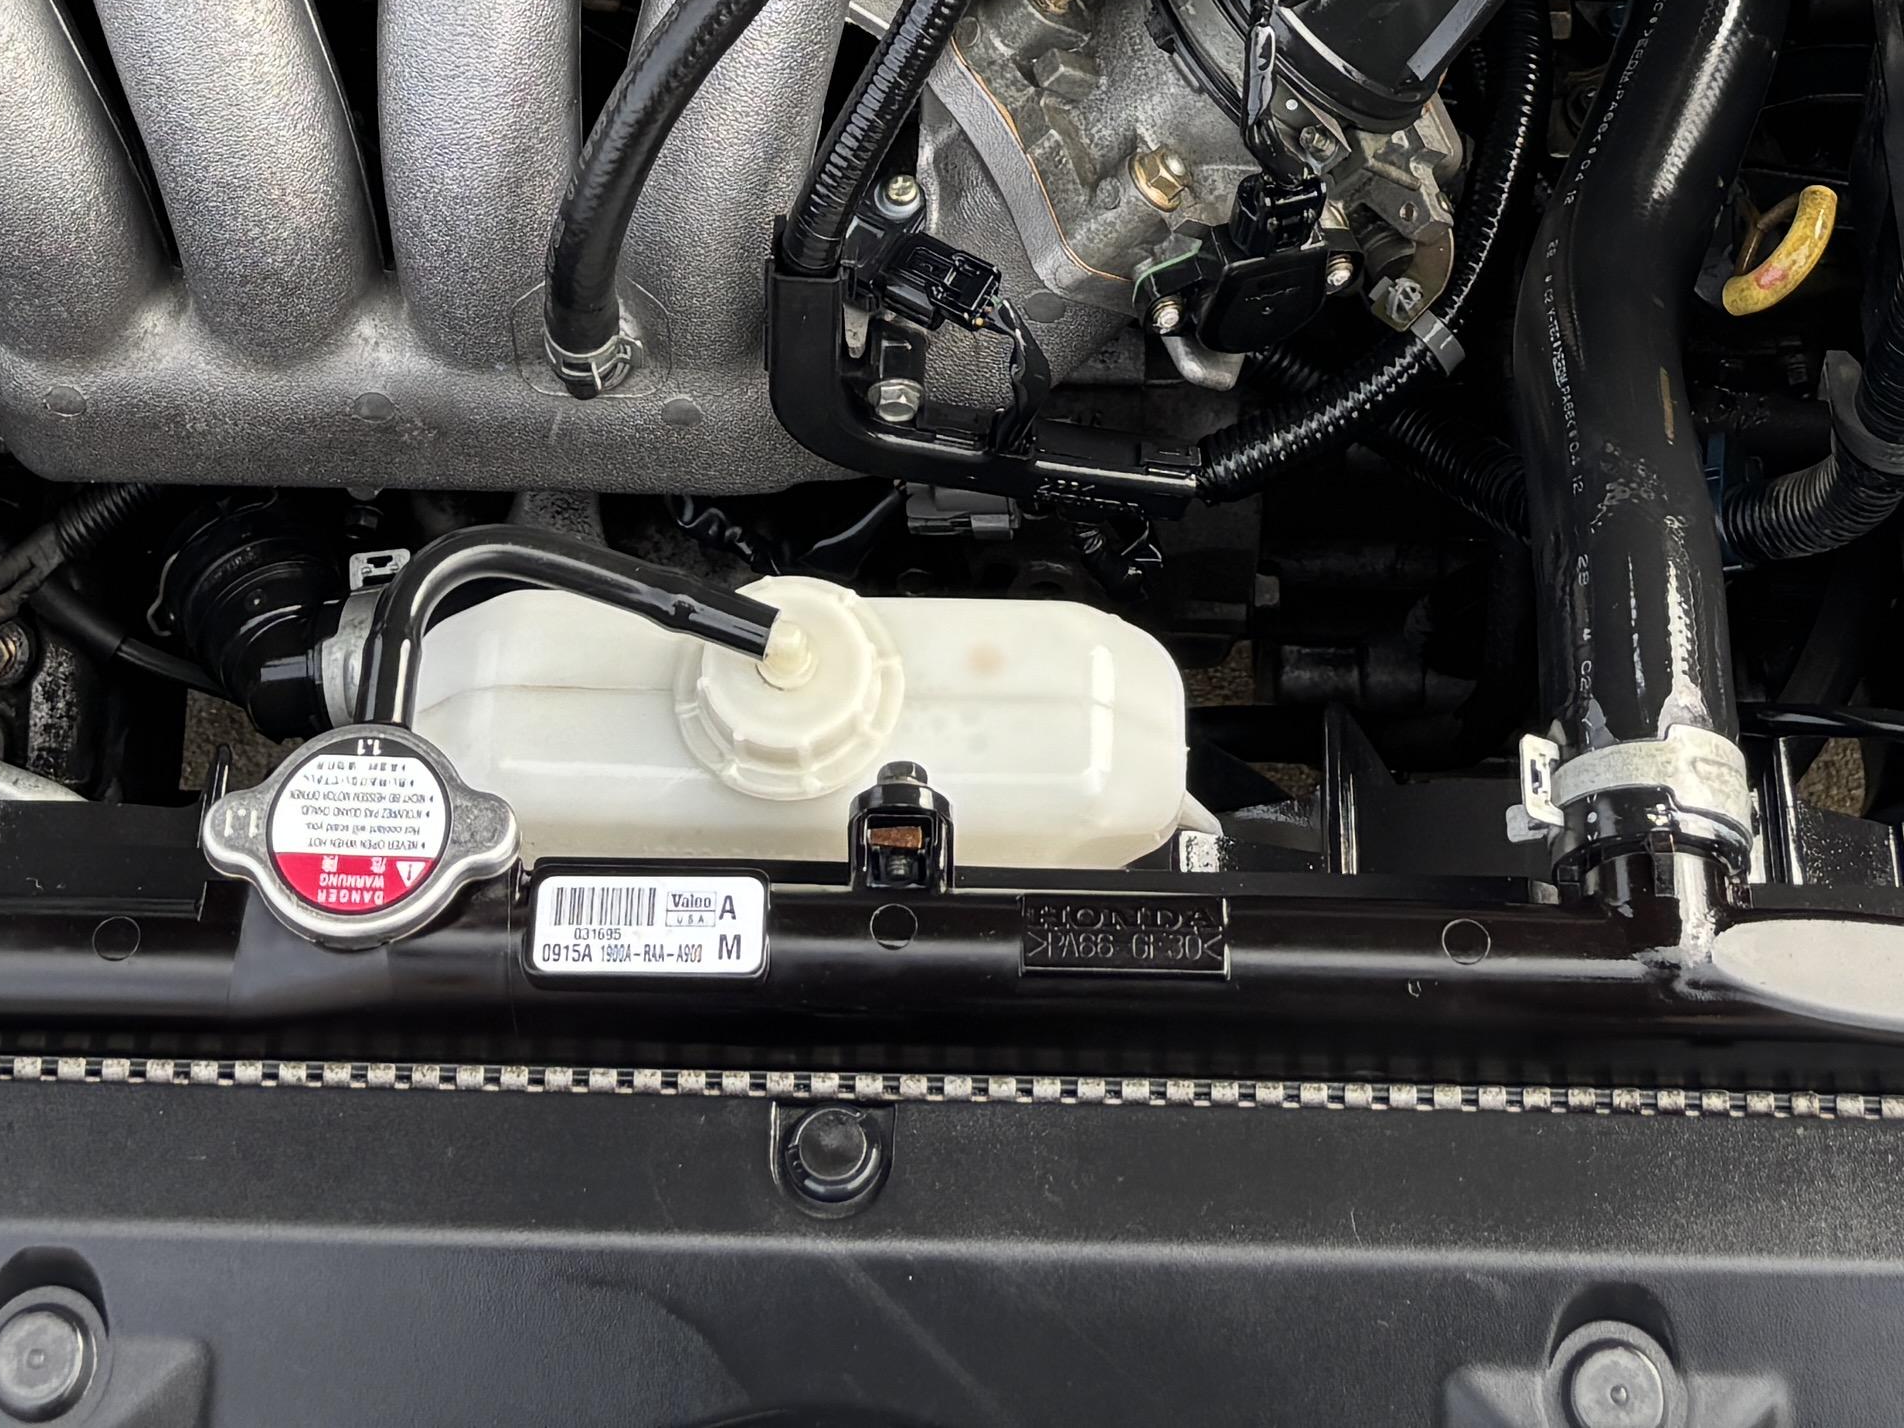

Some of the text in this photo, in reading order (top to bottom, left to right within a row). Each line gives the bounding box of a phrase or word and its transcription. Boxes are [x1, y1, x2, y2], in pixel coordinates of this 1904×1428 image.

[356, 739, 381, 756] 1.1
[307, 837, 418, 850] NEVER OPEN WHEN HOT
[319, 873, 384, 887] WARNUNG
[317, 889, 384, 905] DANGER
[718, 895, 737, 920] A
[542, 934, 742, 962] 0915A M
